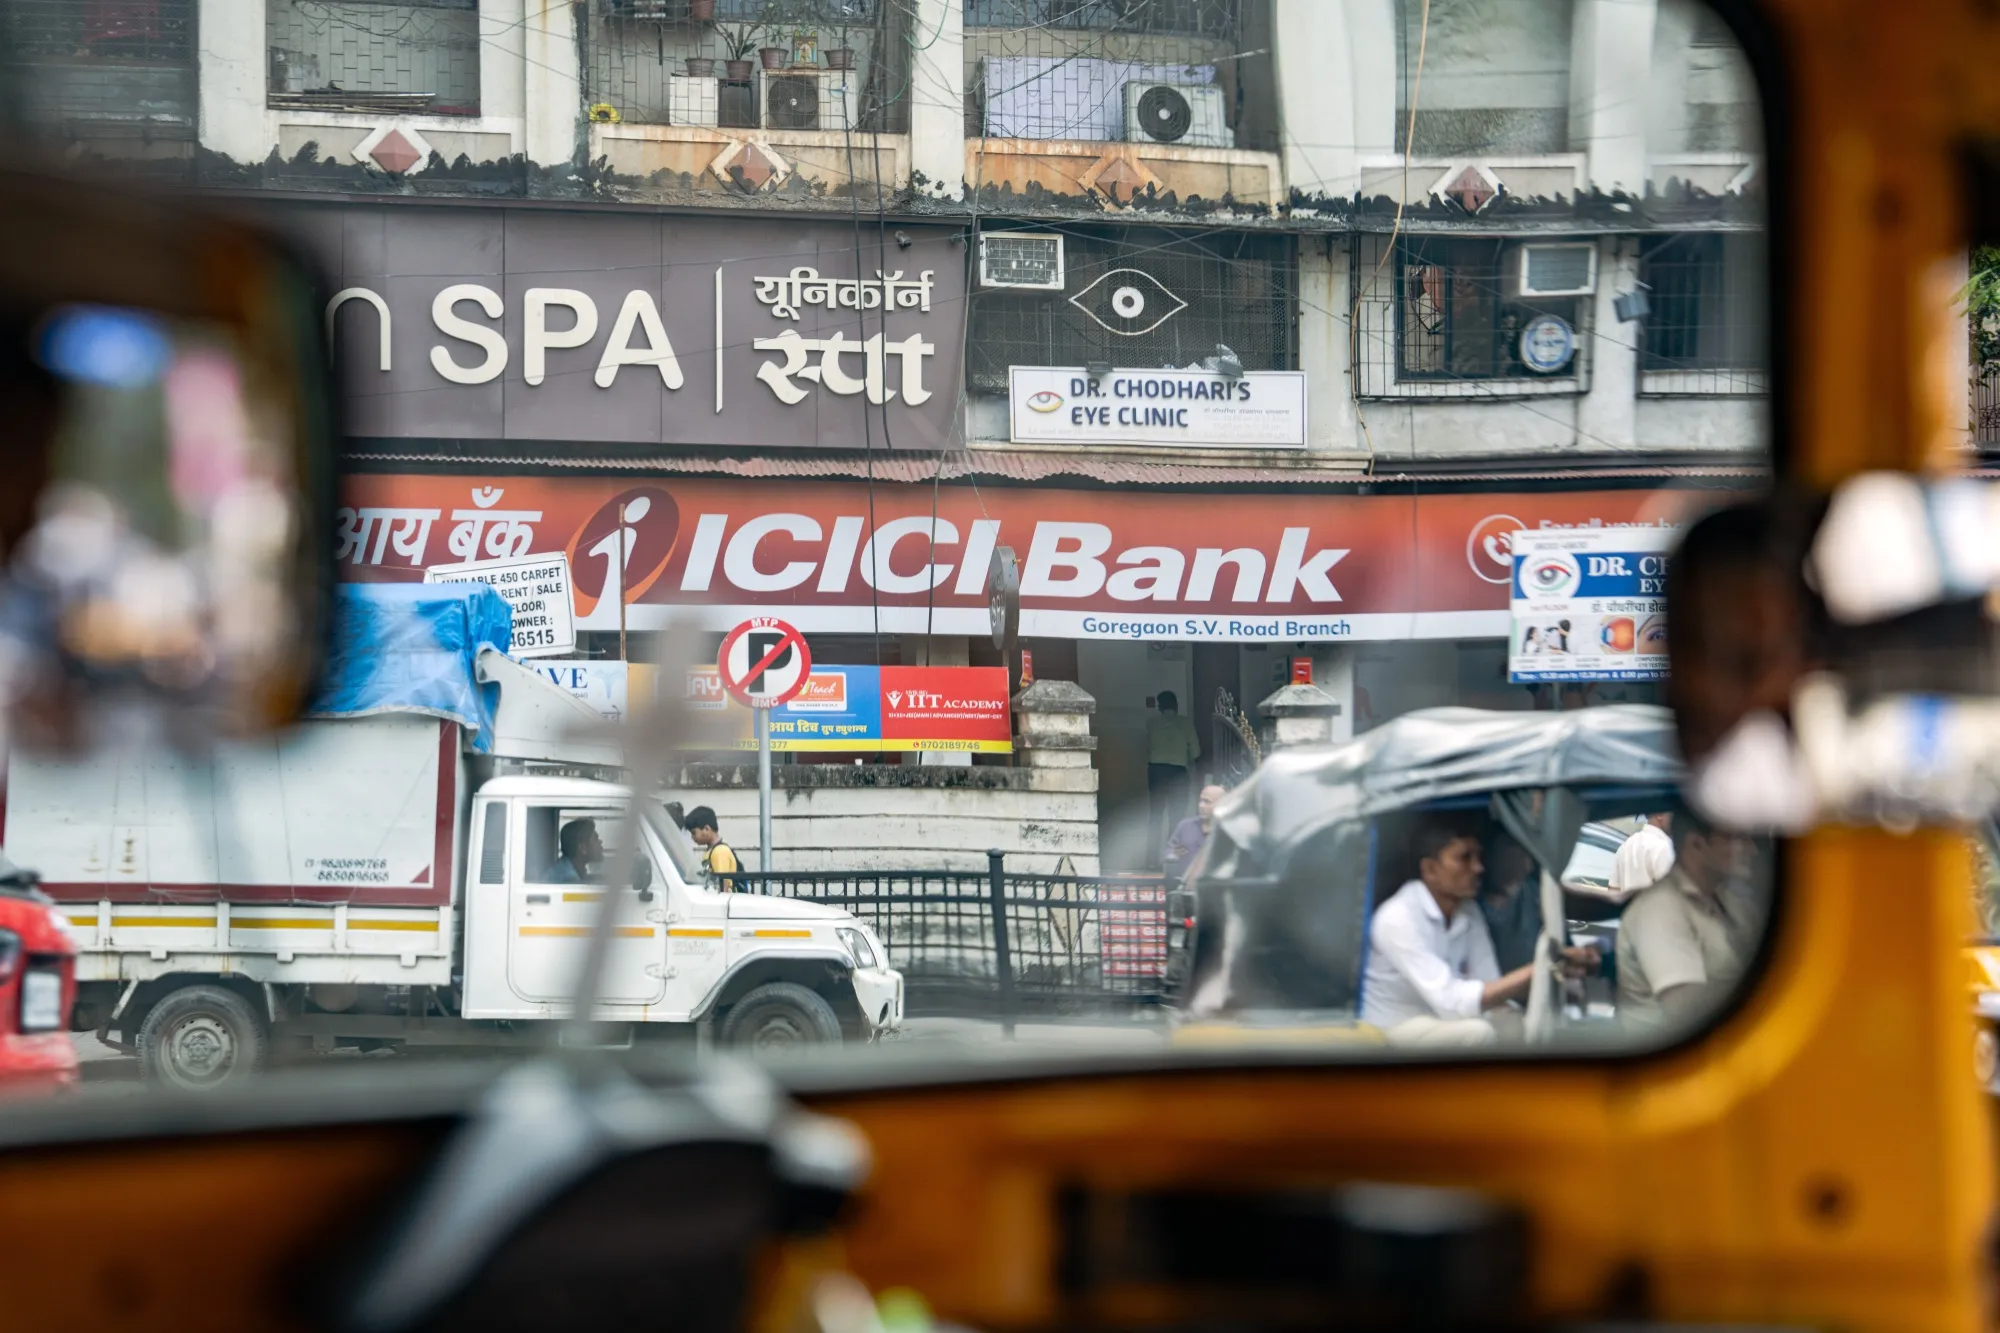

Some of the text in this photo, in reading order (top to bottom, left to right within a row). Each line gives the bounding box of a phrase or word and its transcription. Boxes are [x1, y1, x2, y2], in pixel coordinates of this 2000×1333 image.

[430, 283, 684, 390] SPA
[754, 328, 935, 406] स्पा
[1070, 378, 1251, 401] DR. CHODHARI'S
[1071, 406, 1111, 426] EYE
[1118, 406, 1189, 428] CLINIC
[680, 513, 1001, 594] ICICI
[1019, 520, 1352, 603] Bank
[1587, 556, 1633, 577] DR.
[500, 572, 518, 583] 450
[521, 567, 561, 581] CARPET
[501, 587, 528, 599] RENT
[537, 583, 562, 595] SALE
[751, 617, 779, 628] MTP
[1082, 617, 1351, 638] Goregaon S.V. Road Branch
[907, 694, 1005, 710] IIT ACADEMY
[920, 740, 981, 750] 9702189746
